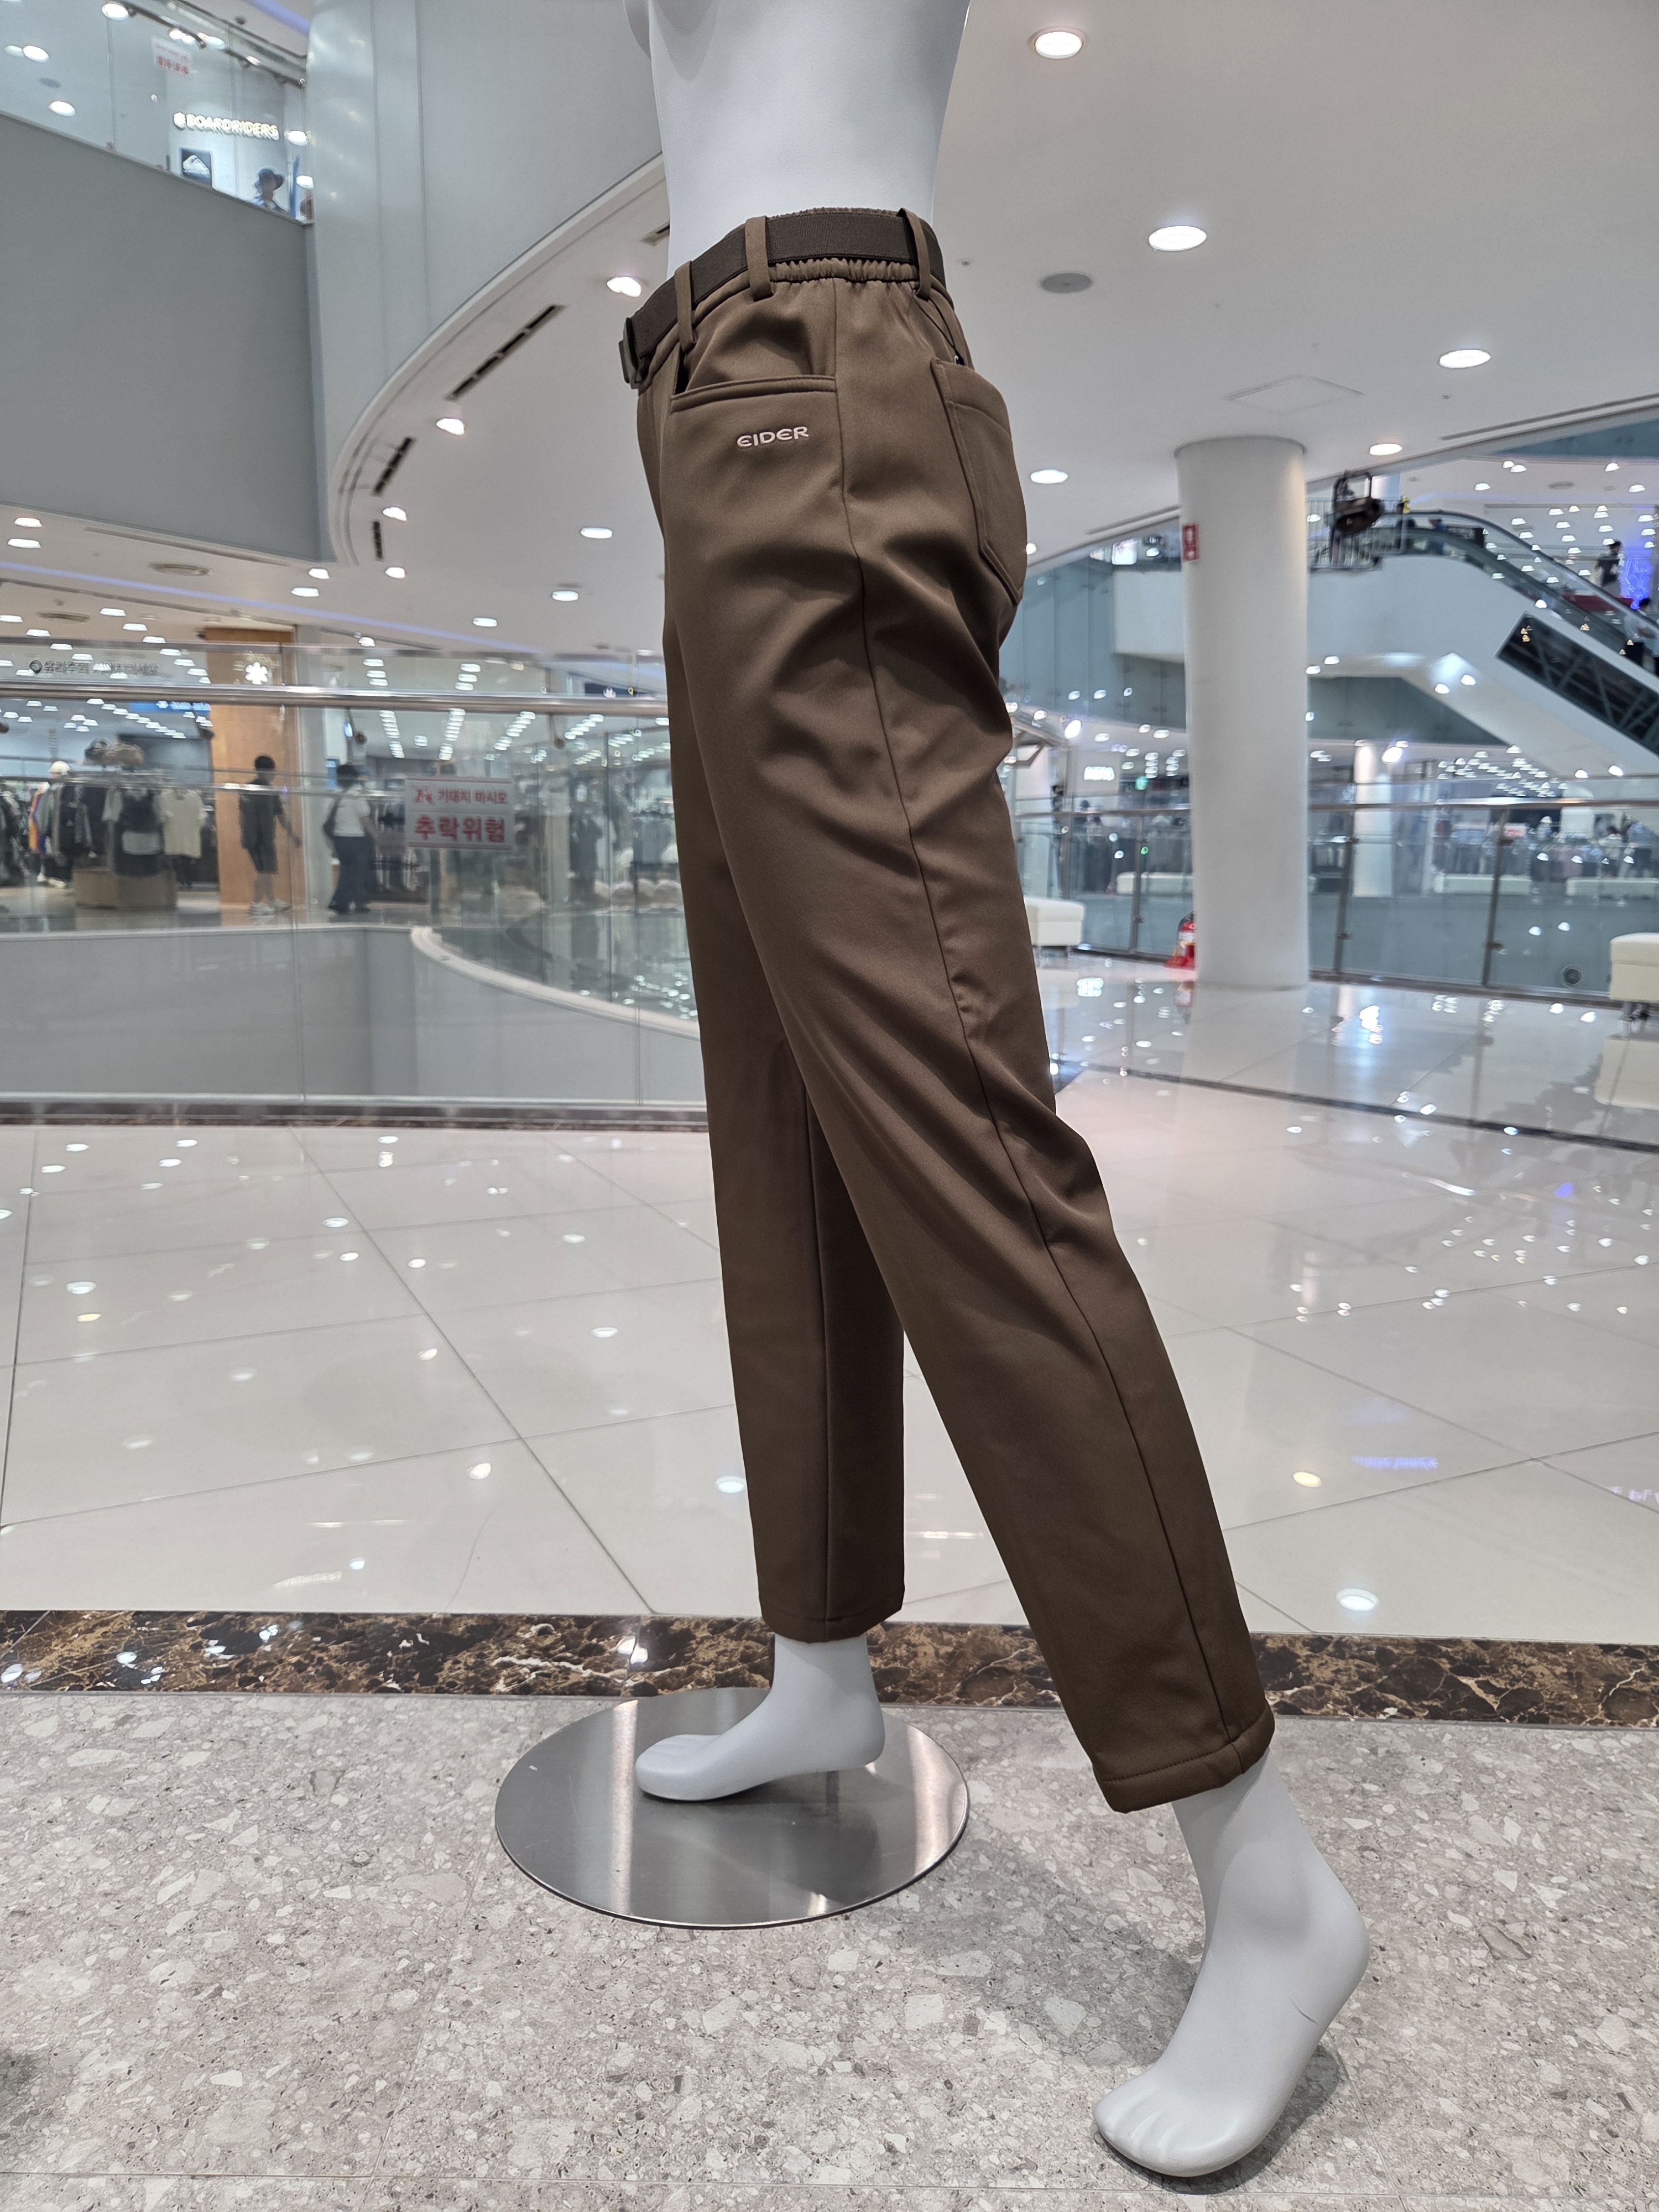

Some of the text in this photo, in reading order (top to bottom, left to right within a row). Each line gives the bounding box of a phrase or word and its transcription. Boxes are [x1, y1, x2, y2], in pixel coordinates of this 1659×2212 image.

[186, 113, 279, 140] BOARDRIDERS
[737, 426, 809, 447] EIDER
[415, 814, 505, 843] 추락위험
